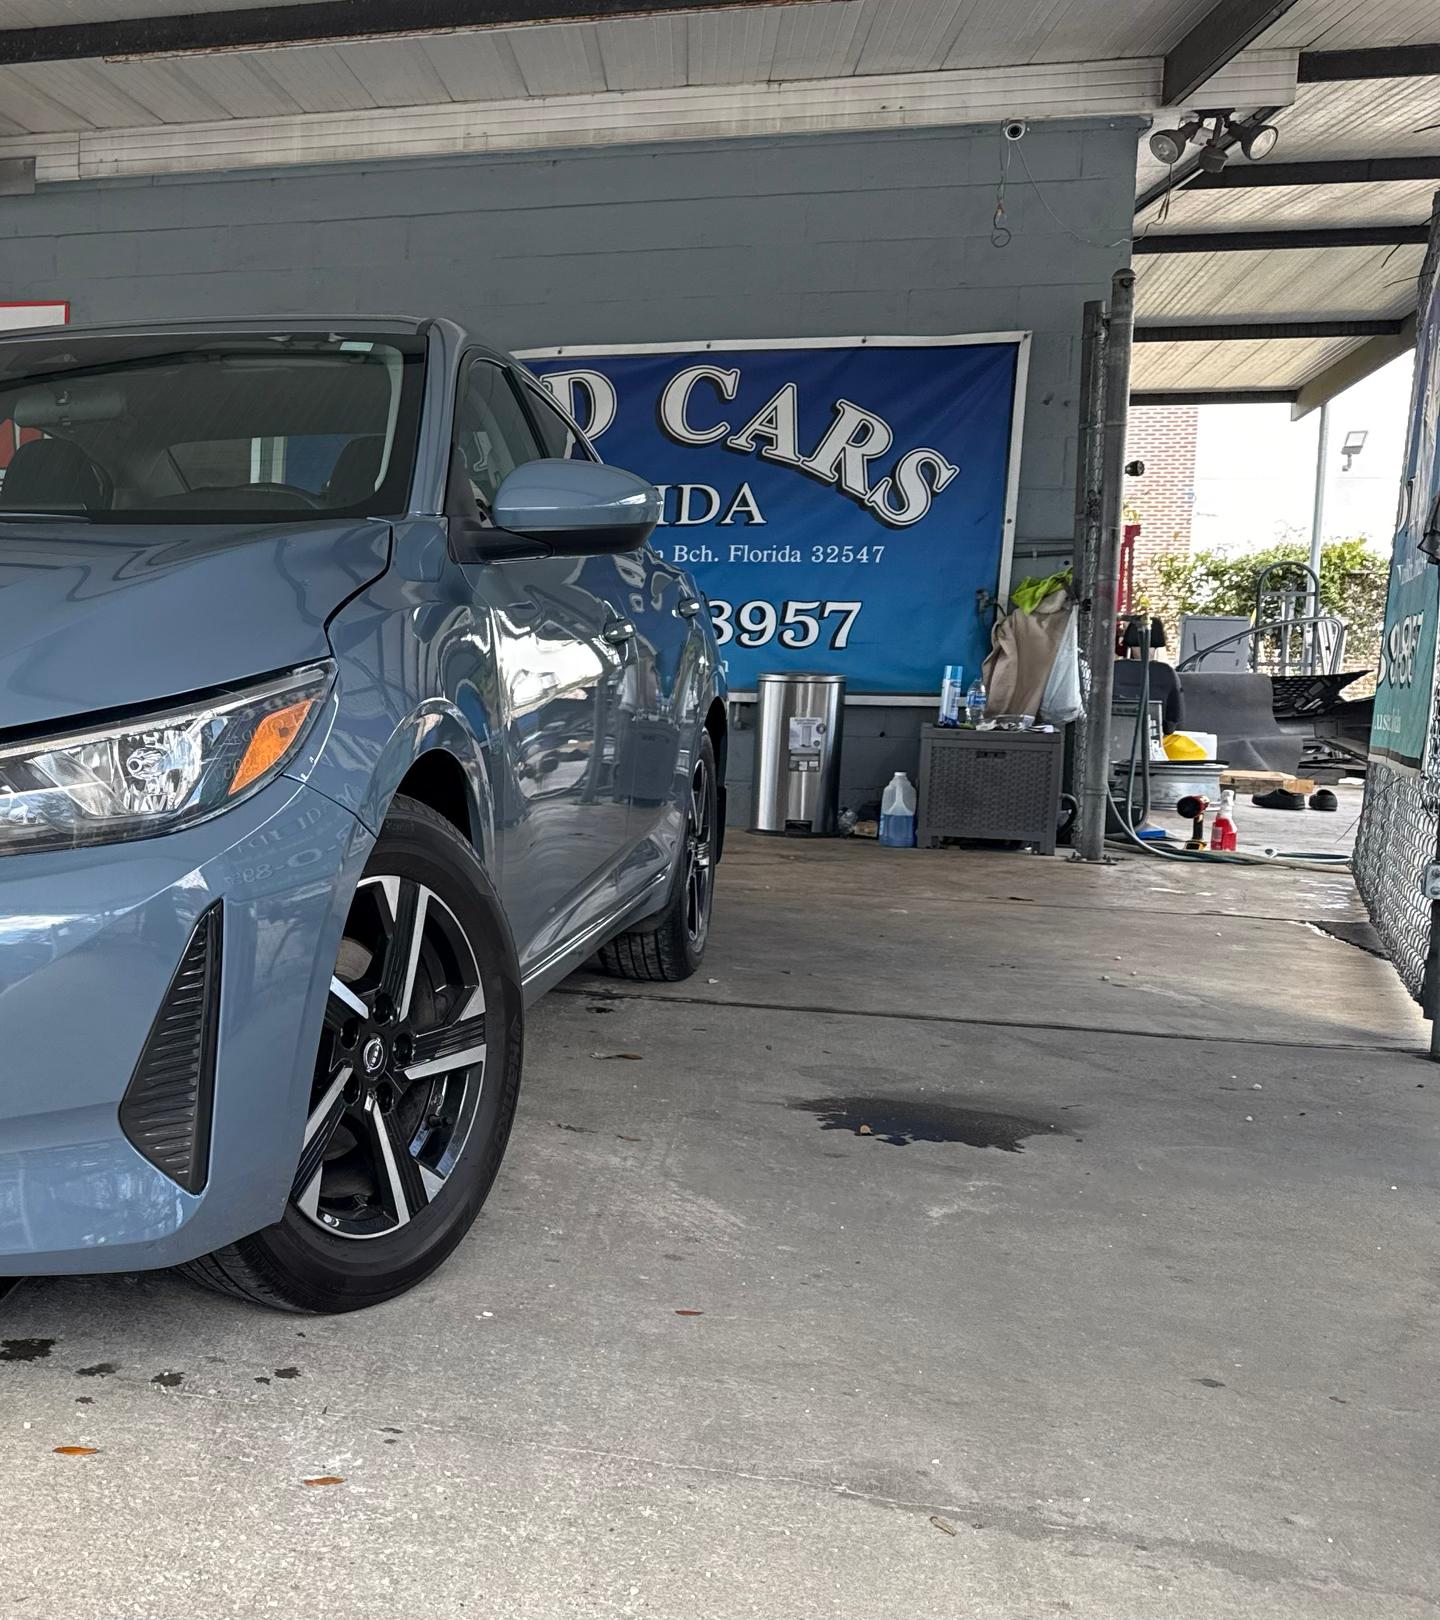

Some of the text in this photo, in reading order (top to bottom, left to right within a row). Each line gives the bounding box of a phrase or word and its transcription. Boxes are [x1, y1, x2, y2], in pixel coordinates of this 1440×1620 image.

[661, 364, 960, 526] CARS
[673, 544, 720, 562] Bch.
[728, 544, 802, 563] Florida
[811, 545, 886, 563] 32547
